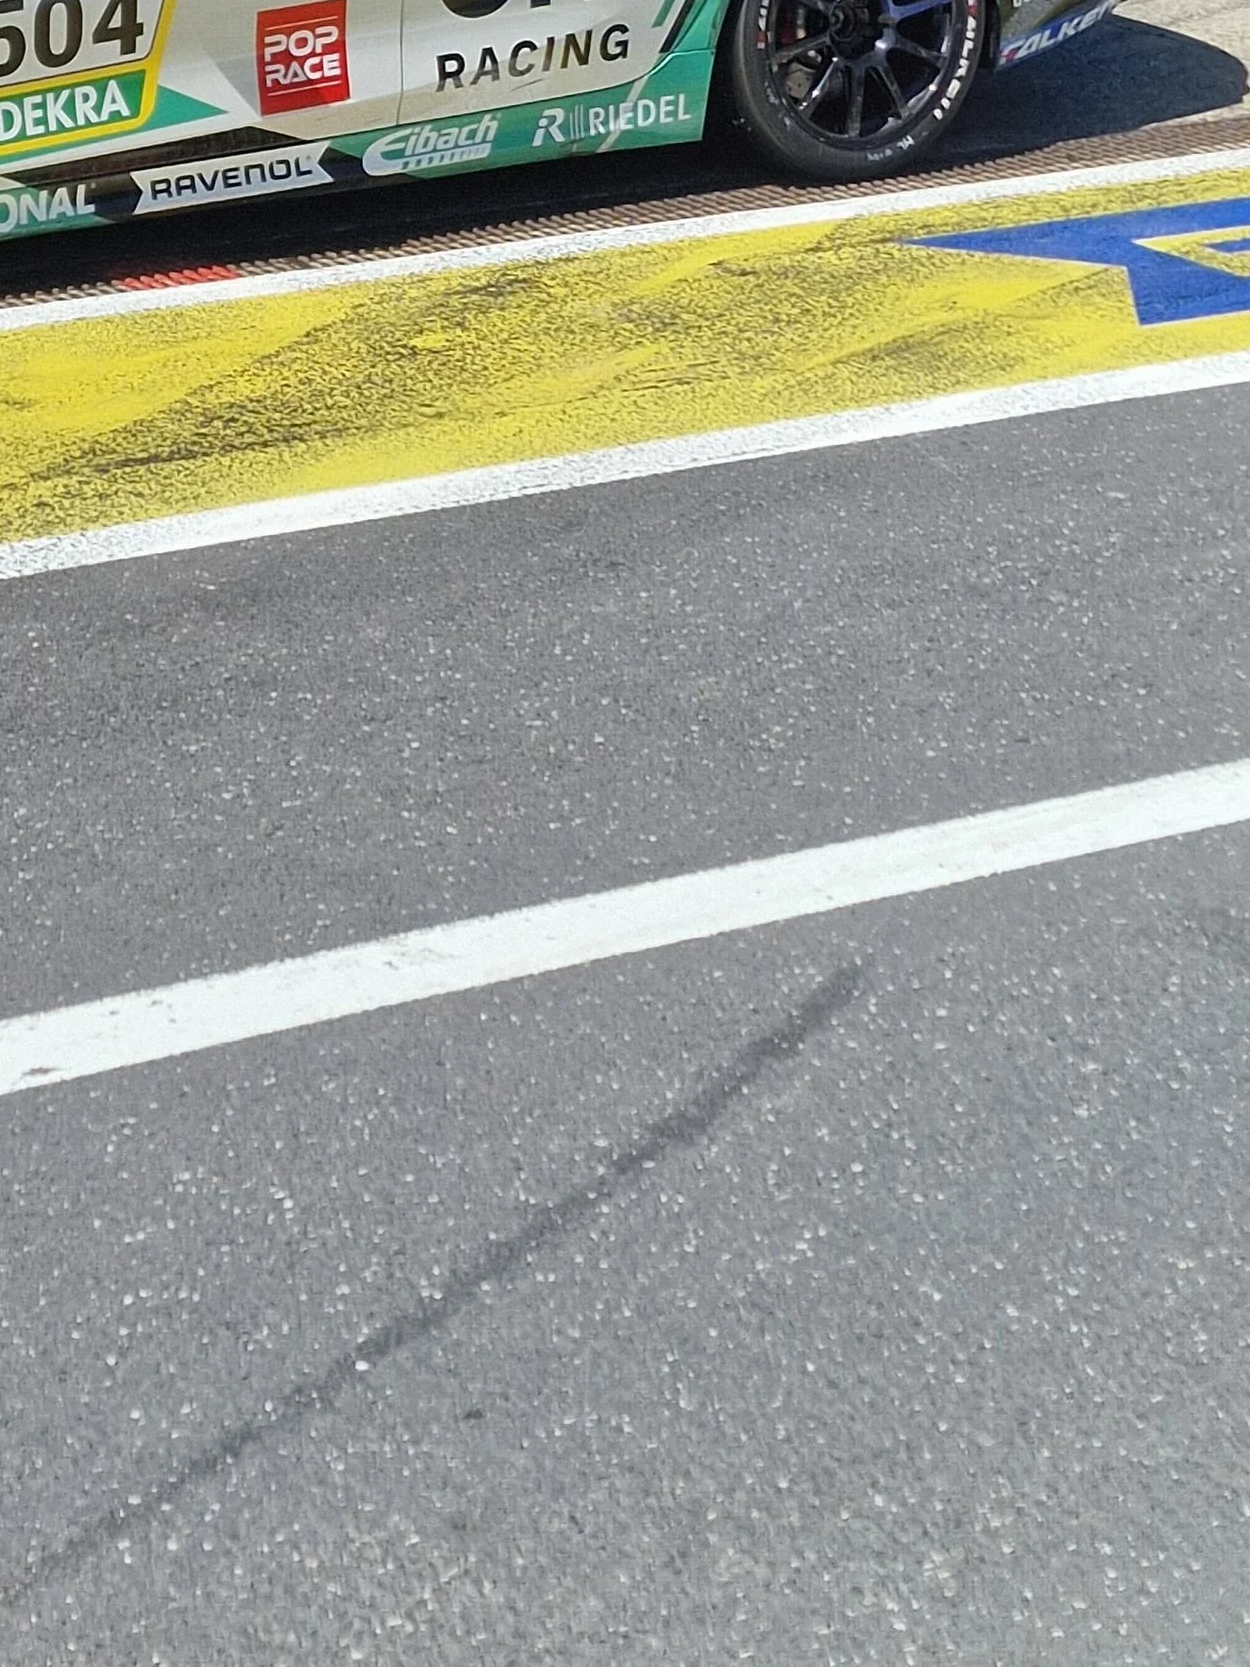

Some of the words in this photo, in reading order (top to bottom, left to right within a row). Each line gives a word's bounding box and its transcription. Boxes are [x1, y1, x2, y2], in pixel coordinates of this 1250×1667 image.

[263, 25, 340, 63] POP
[436, 23, 630, 93] RACING
[265, 52, 342, 88] RACE
[589, 95, 693, 136] RIEDEL
[362, 112, 501, 177] Eibach
[150, 158, 313, 202] RAVENOL
